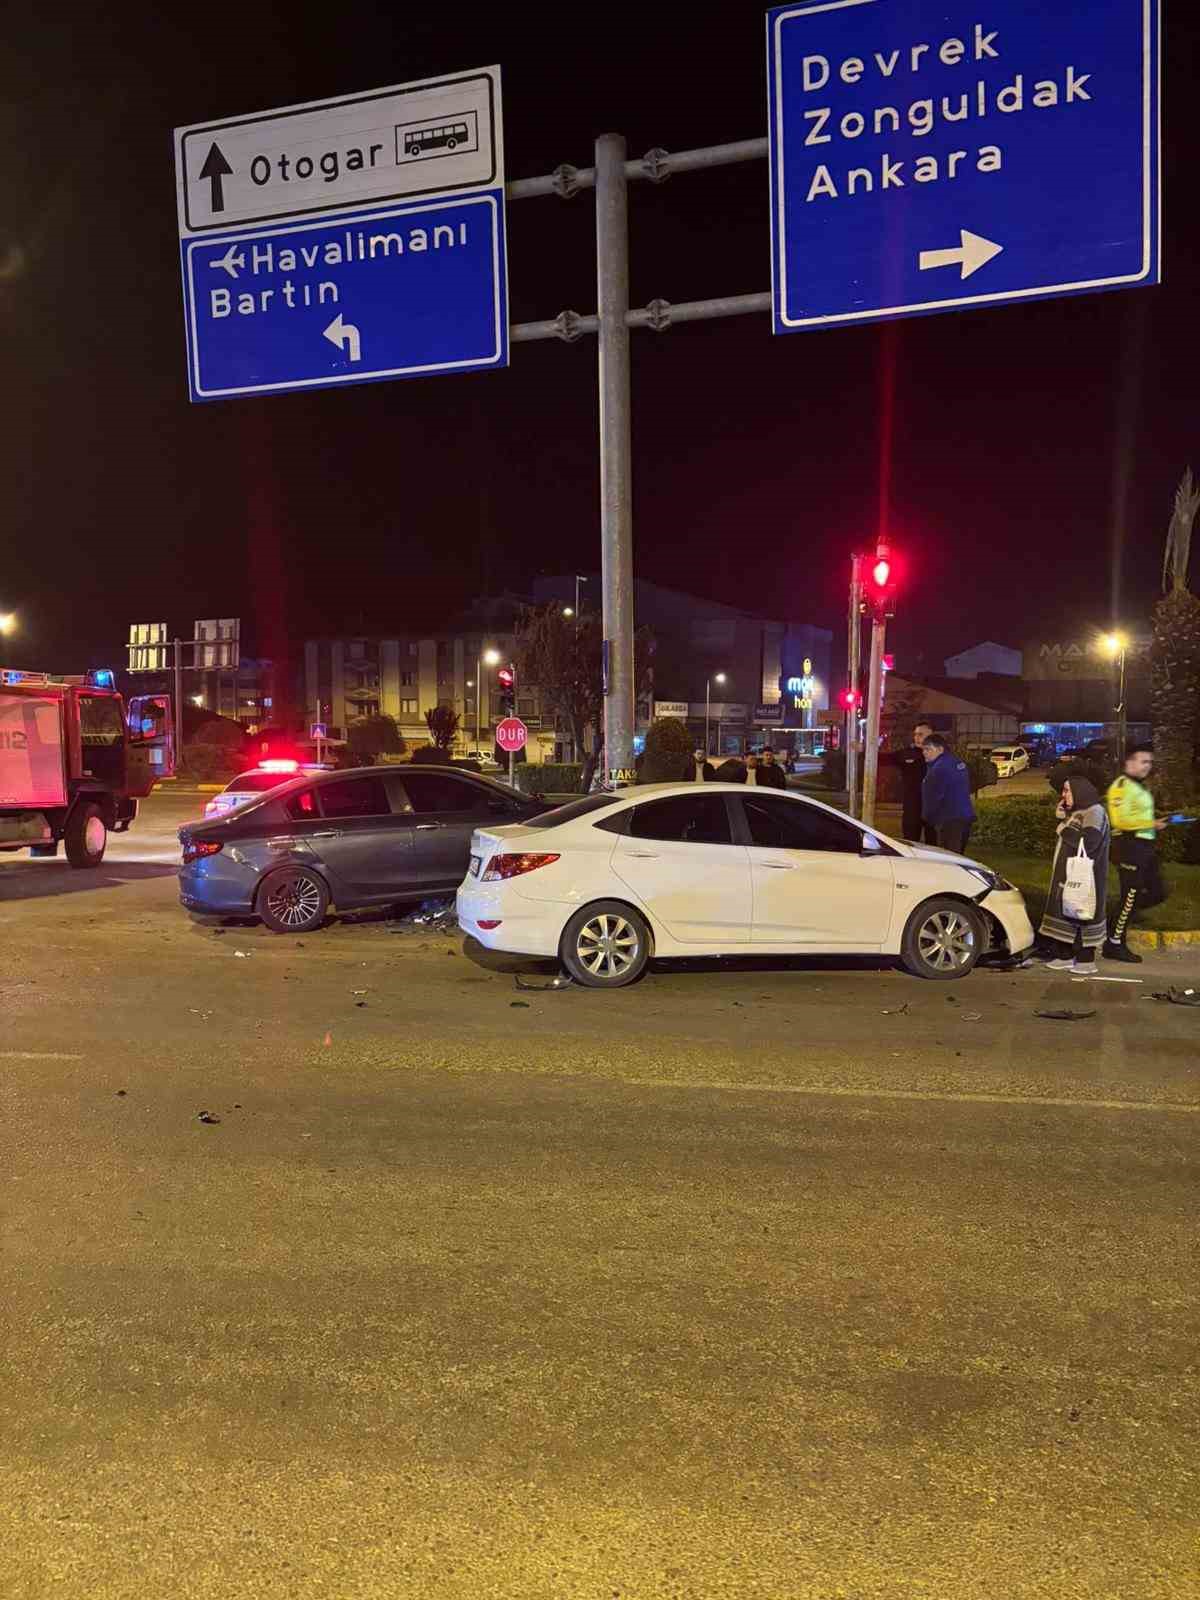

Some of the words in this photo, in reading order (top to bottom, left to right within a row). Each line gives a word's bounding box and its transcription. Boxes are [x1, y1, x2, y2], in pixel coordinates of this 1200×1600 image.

[802, 24, 1000, 92] Devrek
[803, 66, 1092, 146] Zonguldak
[250, 143, 384, 186] Otogar
[806, 145, 1003, 202] Ankara
[252, 223, 468, 274] Havalimanı
[210, 280, 339, 319] Bartın
[499, 727, 525, 741] DUR
